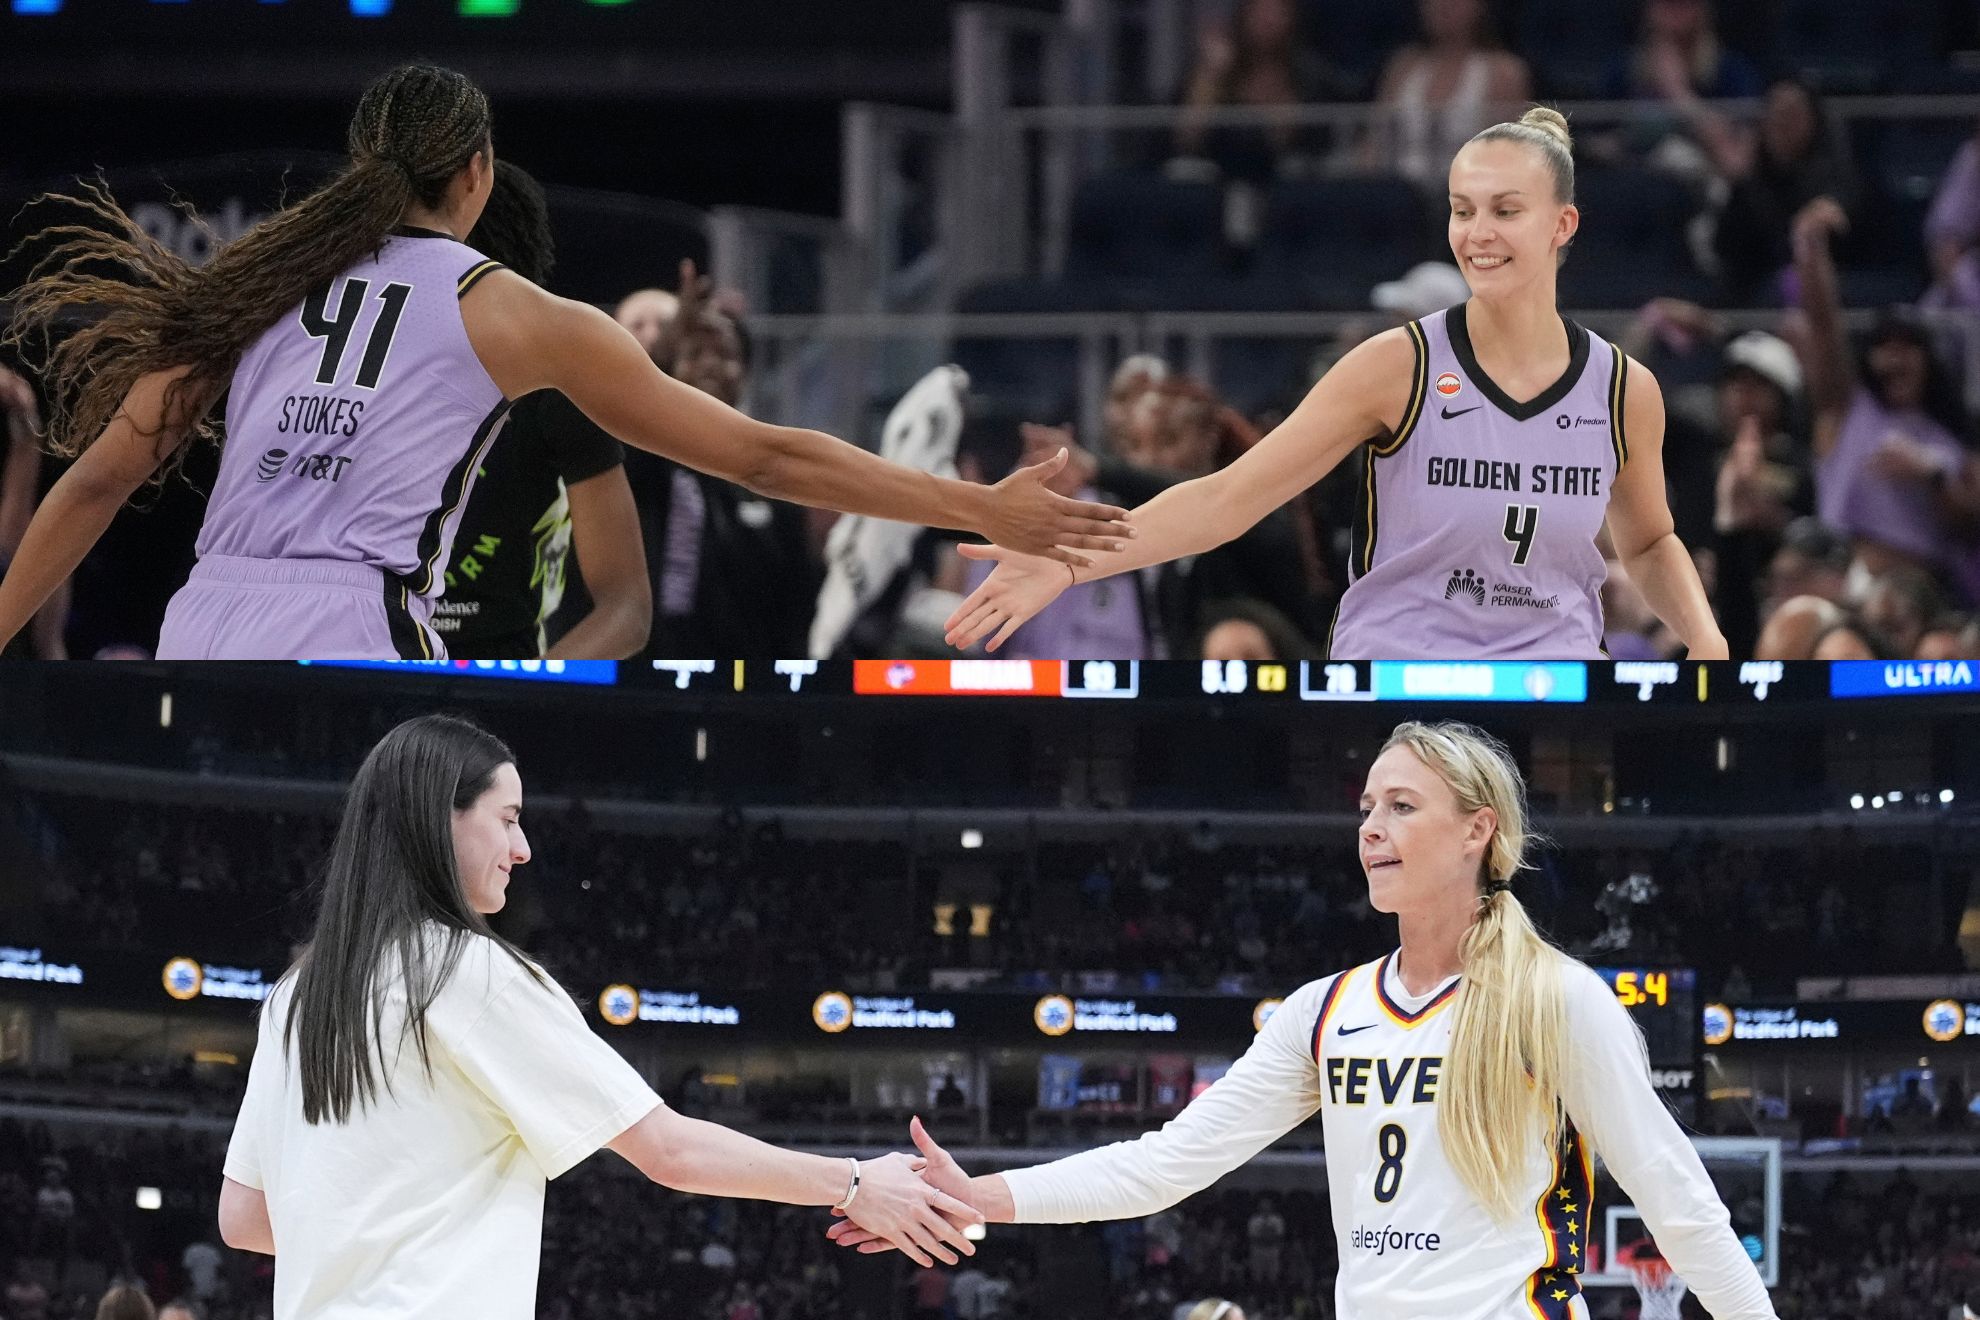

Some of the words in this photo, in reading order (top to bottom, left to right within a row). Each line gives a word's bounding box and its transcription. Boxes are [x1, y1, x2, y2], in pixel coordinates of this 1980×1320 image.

[299, 276, 415, 391] 41
[277, 395, 365, 437] STOKES
[1574, 415, 1607, 428] freedom
[1427, 456, 1521, 492] GOLDEN
[1531, 464, 1602, 496] STATE
[1502, 503, 1540, 567] 4
[1491, 594, 1560, 609] PERMANENTE
[1493, 583, 1532, 597] KAISER
[1884, 661, 1973, 689] ULTRA
[1615, 971, 1667, 1006] 5.4
[1326, 1056, 1443, 1105] FEVE
[1373, 1121, 1408, 1205] 8
[1351, 1224, 1441, 1256] salesforce
